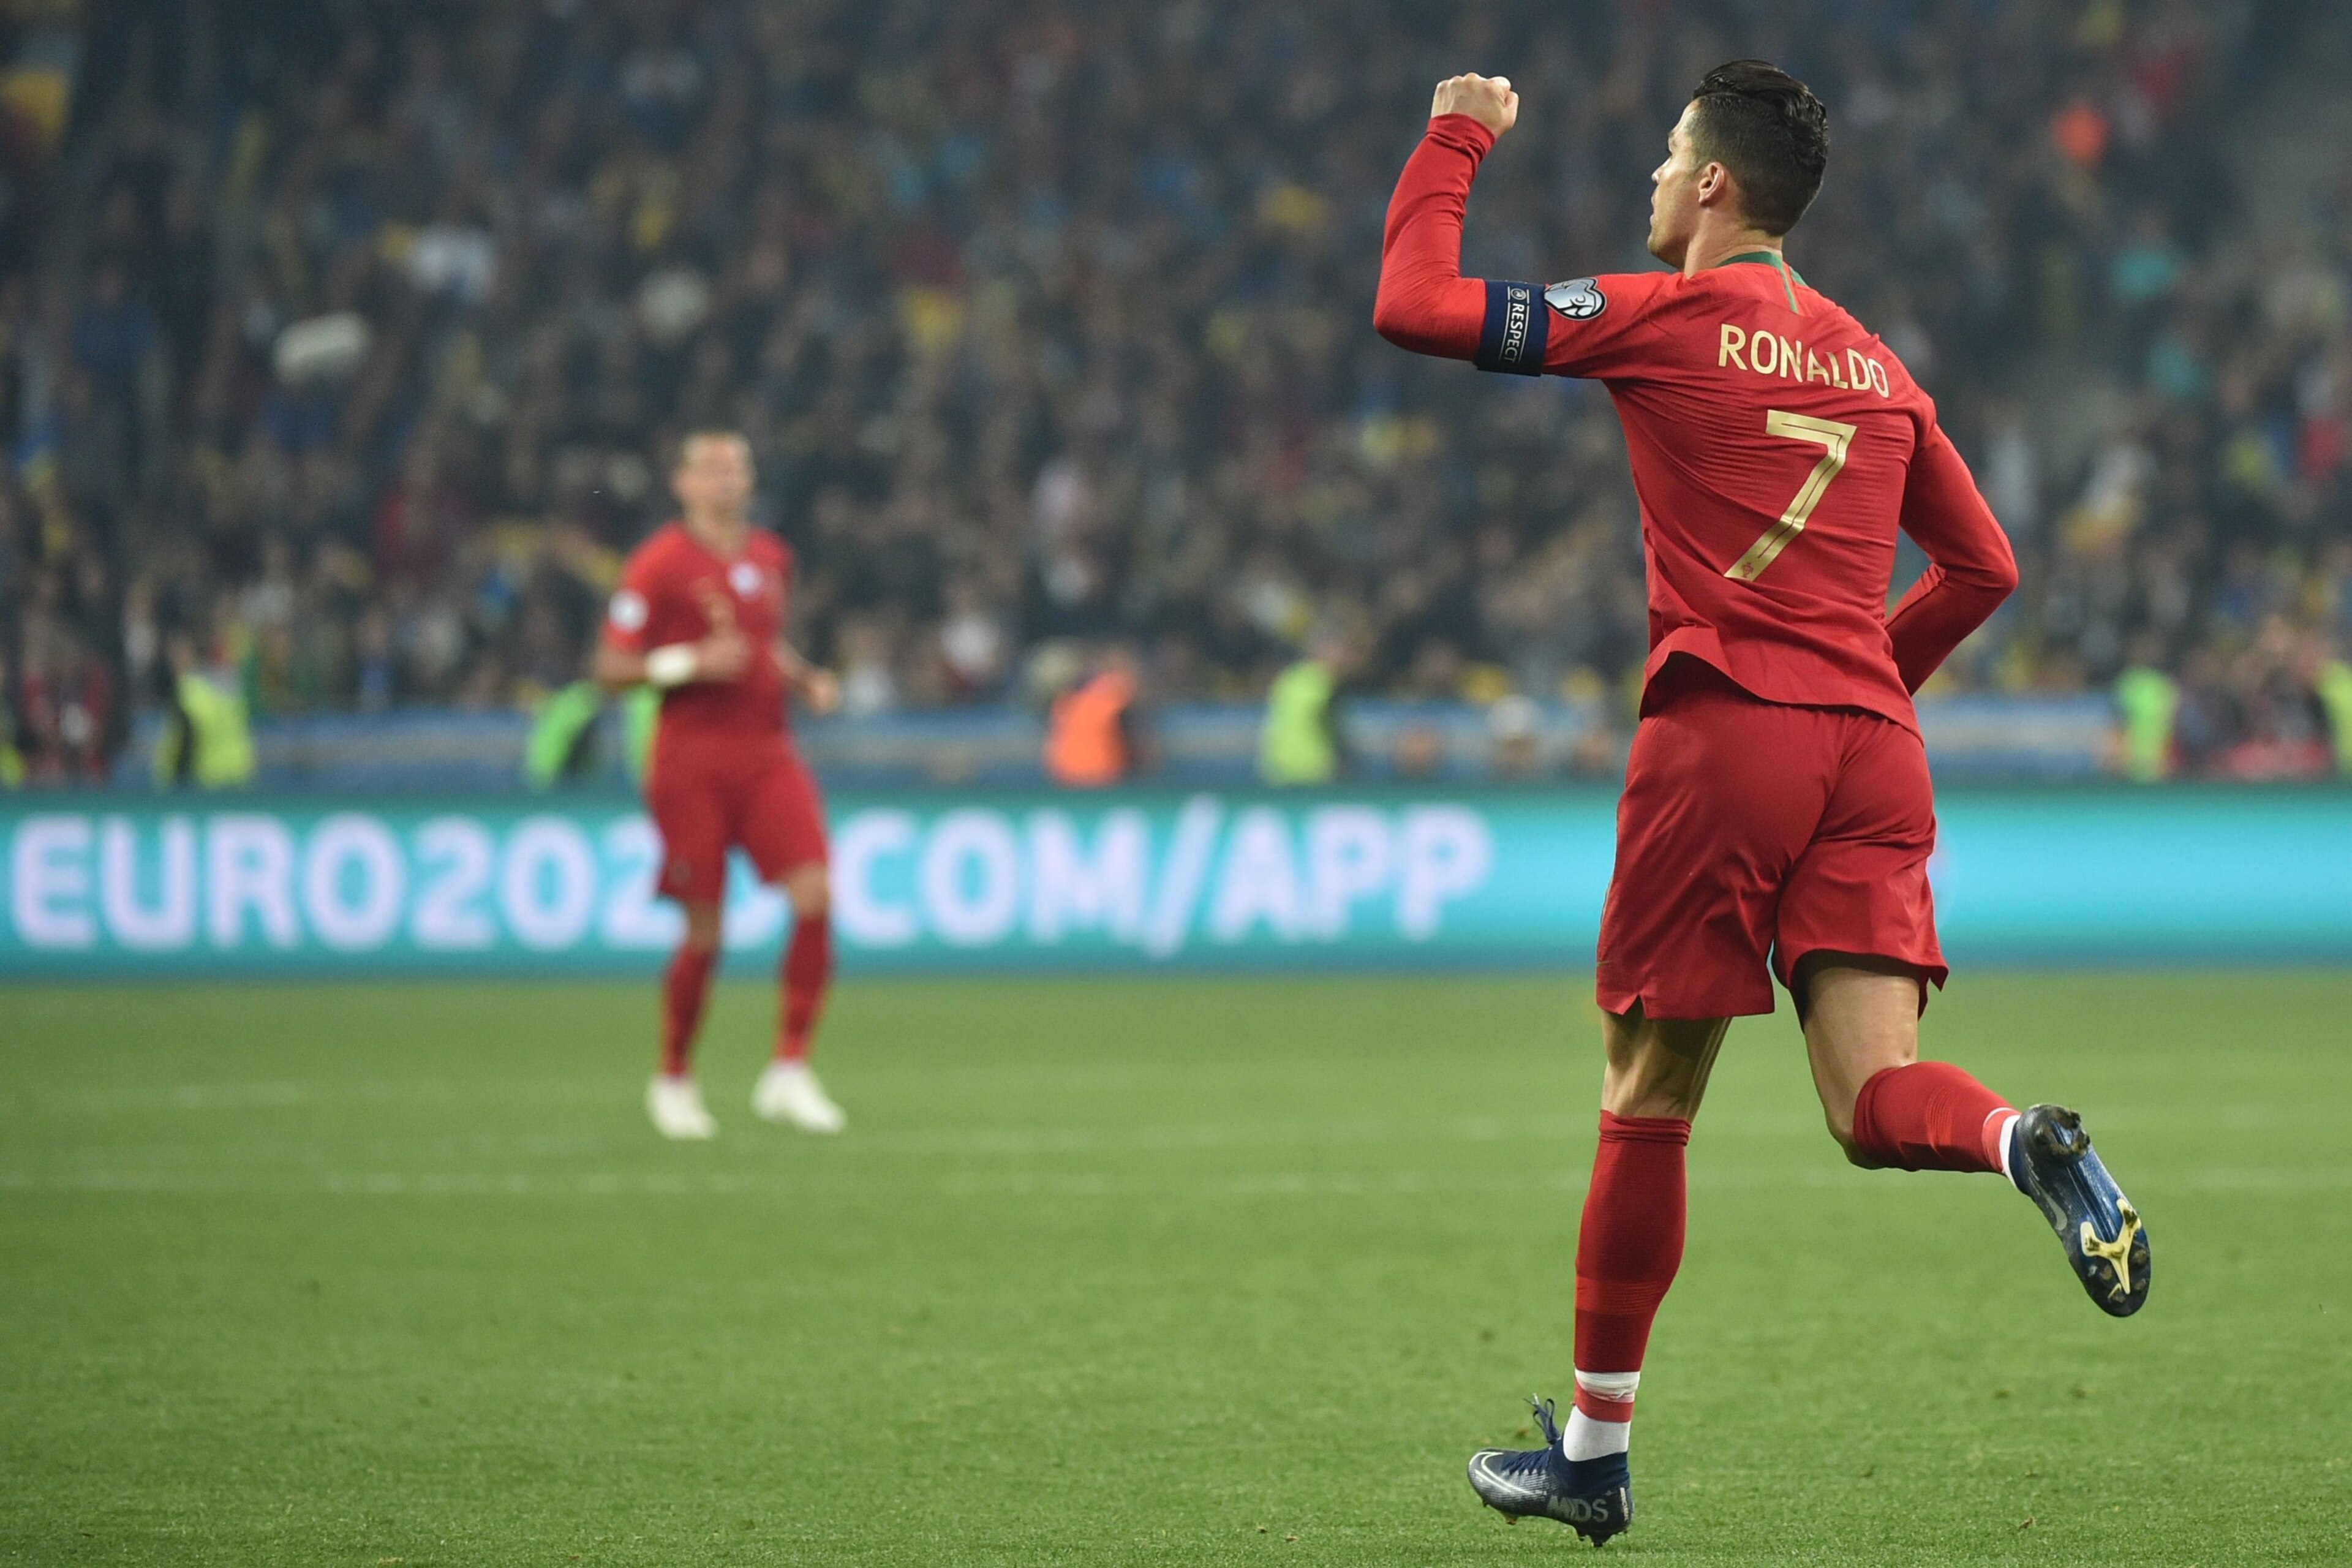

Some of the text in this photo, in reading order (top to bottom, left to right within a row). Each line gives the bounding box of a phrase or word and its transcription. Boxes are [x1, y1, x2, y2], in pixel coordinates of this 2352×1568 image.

[1503, 303, 1525, 363] RESPECT
[1717, 323, 1890, 398] RONALDO
[1723, 409, 1858, 582] 7
